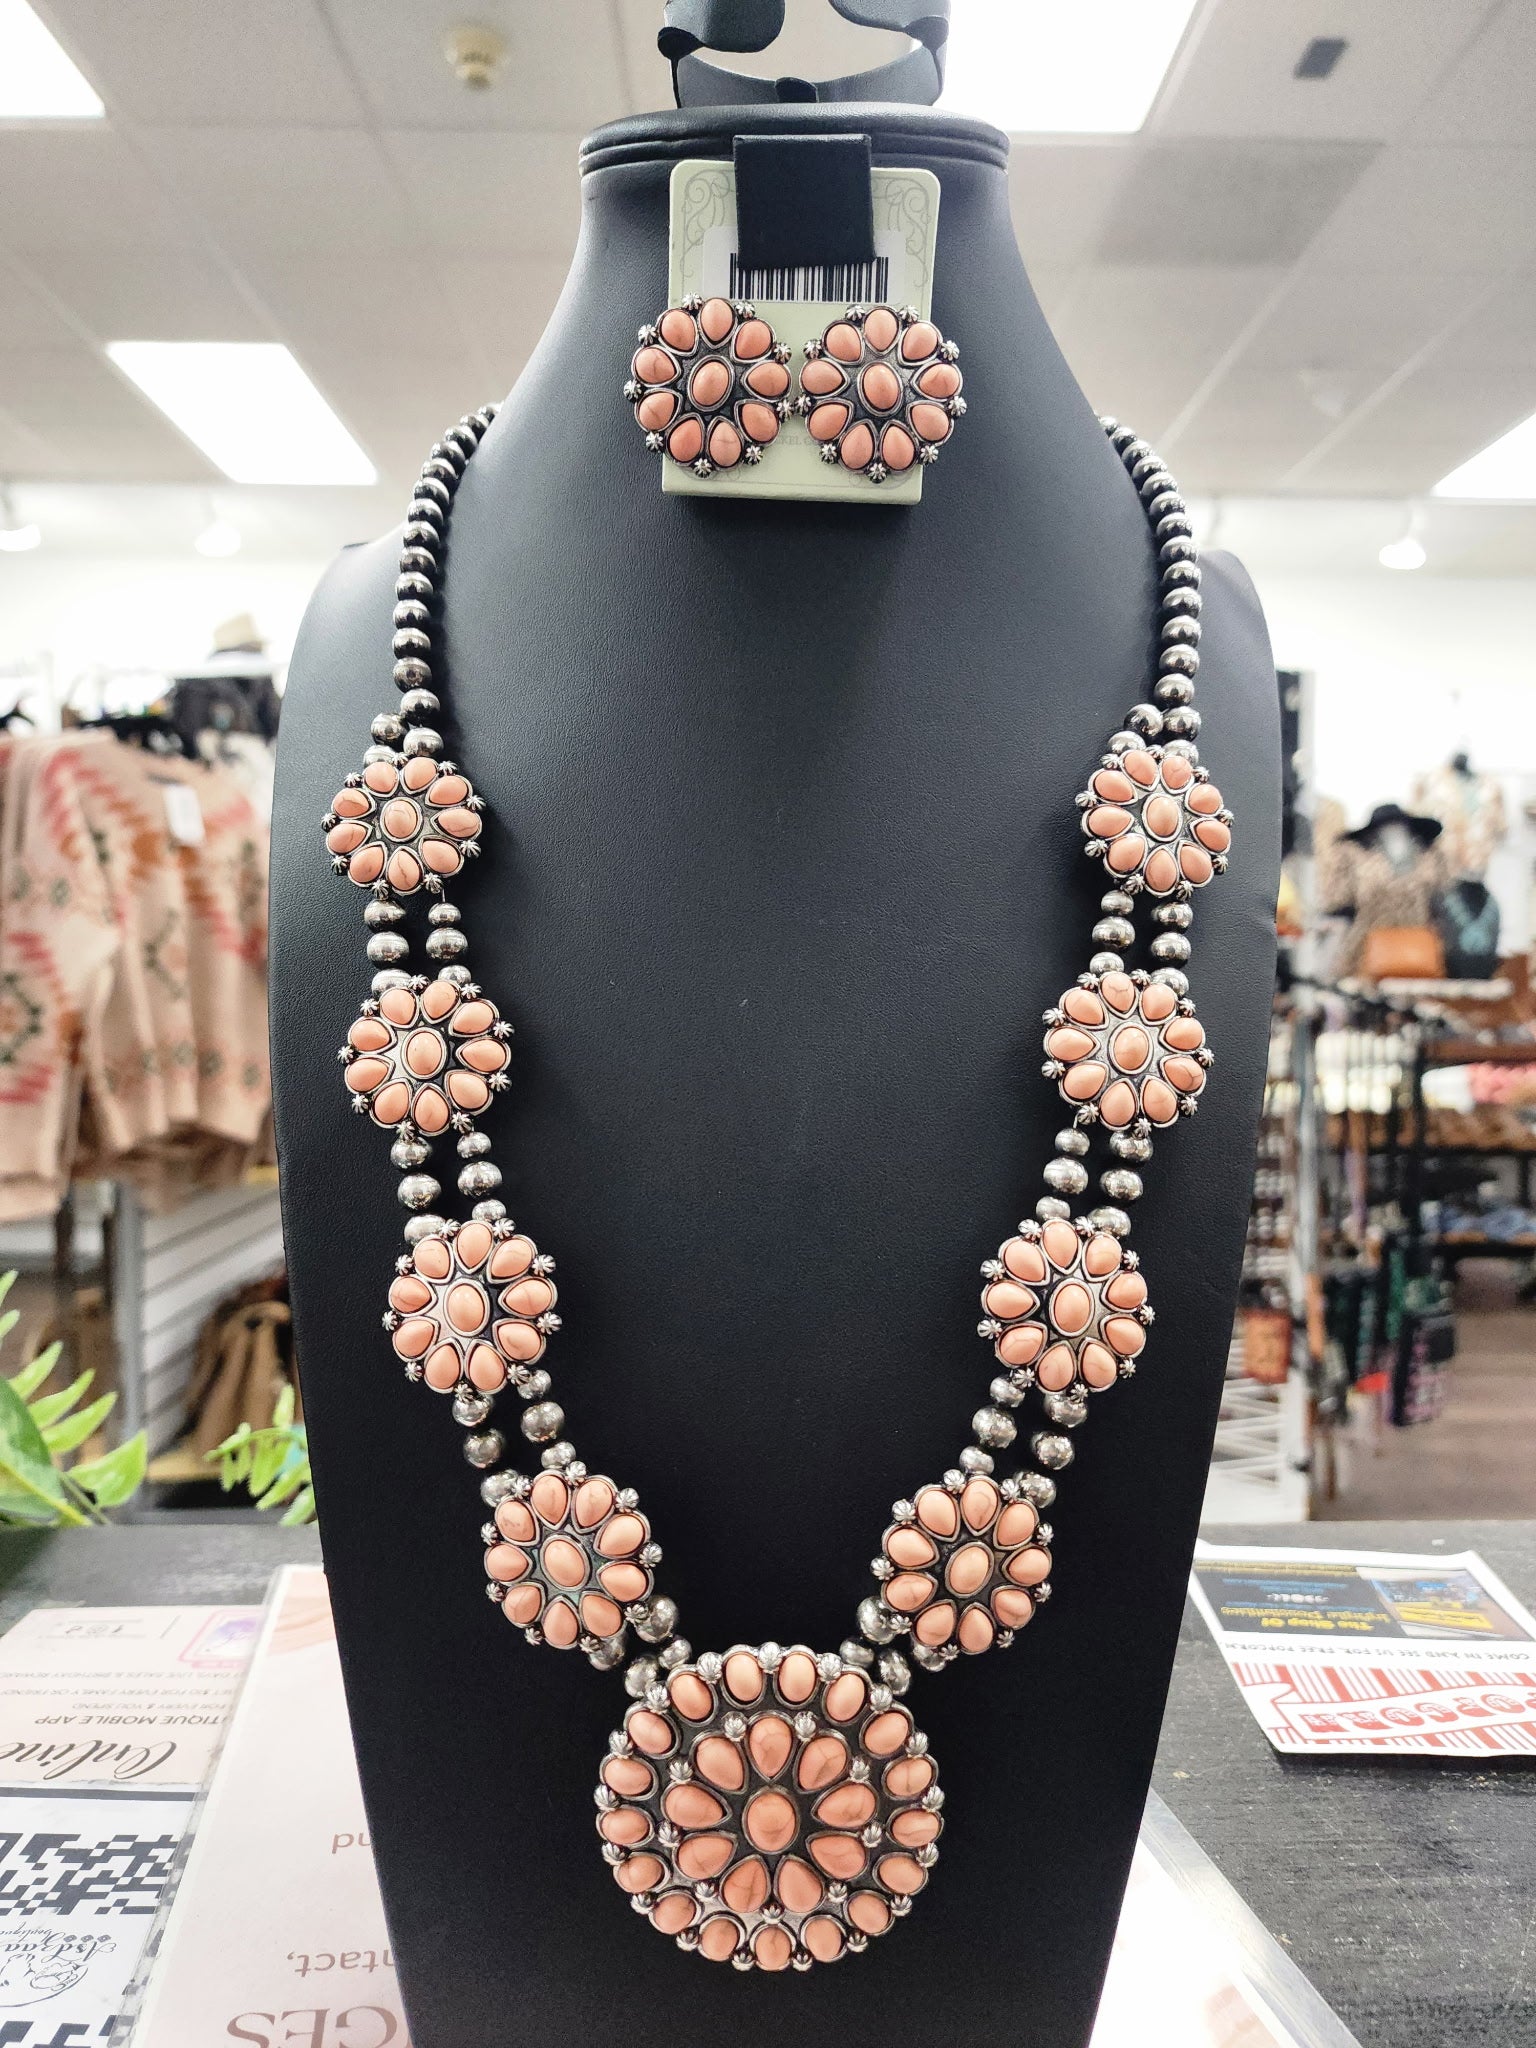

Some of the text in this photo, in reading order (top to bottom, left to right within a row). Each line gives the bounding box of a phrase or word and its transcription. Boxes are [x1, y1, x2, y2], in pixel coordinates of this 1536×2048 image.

[1299, 1645, 1336, 1654] FREE
[1425, 1651, 1460, 1660] AND
[1485, 1652, 1530, 1661] COME
[34, 1714, 78, 1725] APP
[79, 1714, 157, 1725] MOBILE
[0, 1740, 176, 1780] Online
[331, 1832, 371, 1855] nd
[286, 1949, 394, 1978] ntact,
[227, 2005, 398, 2048] GES
